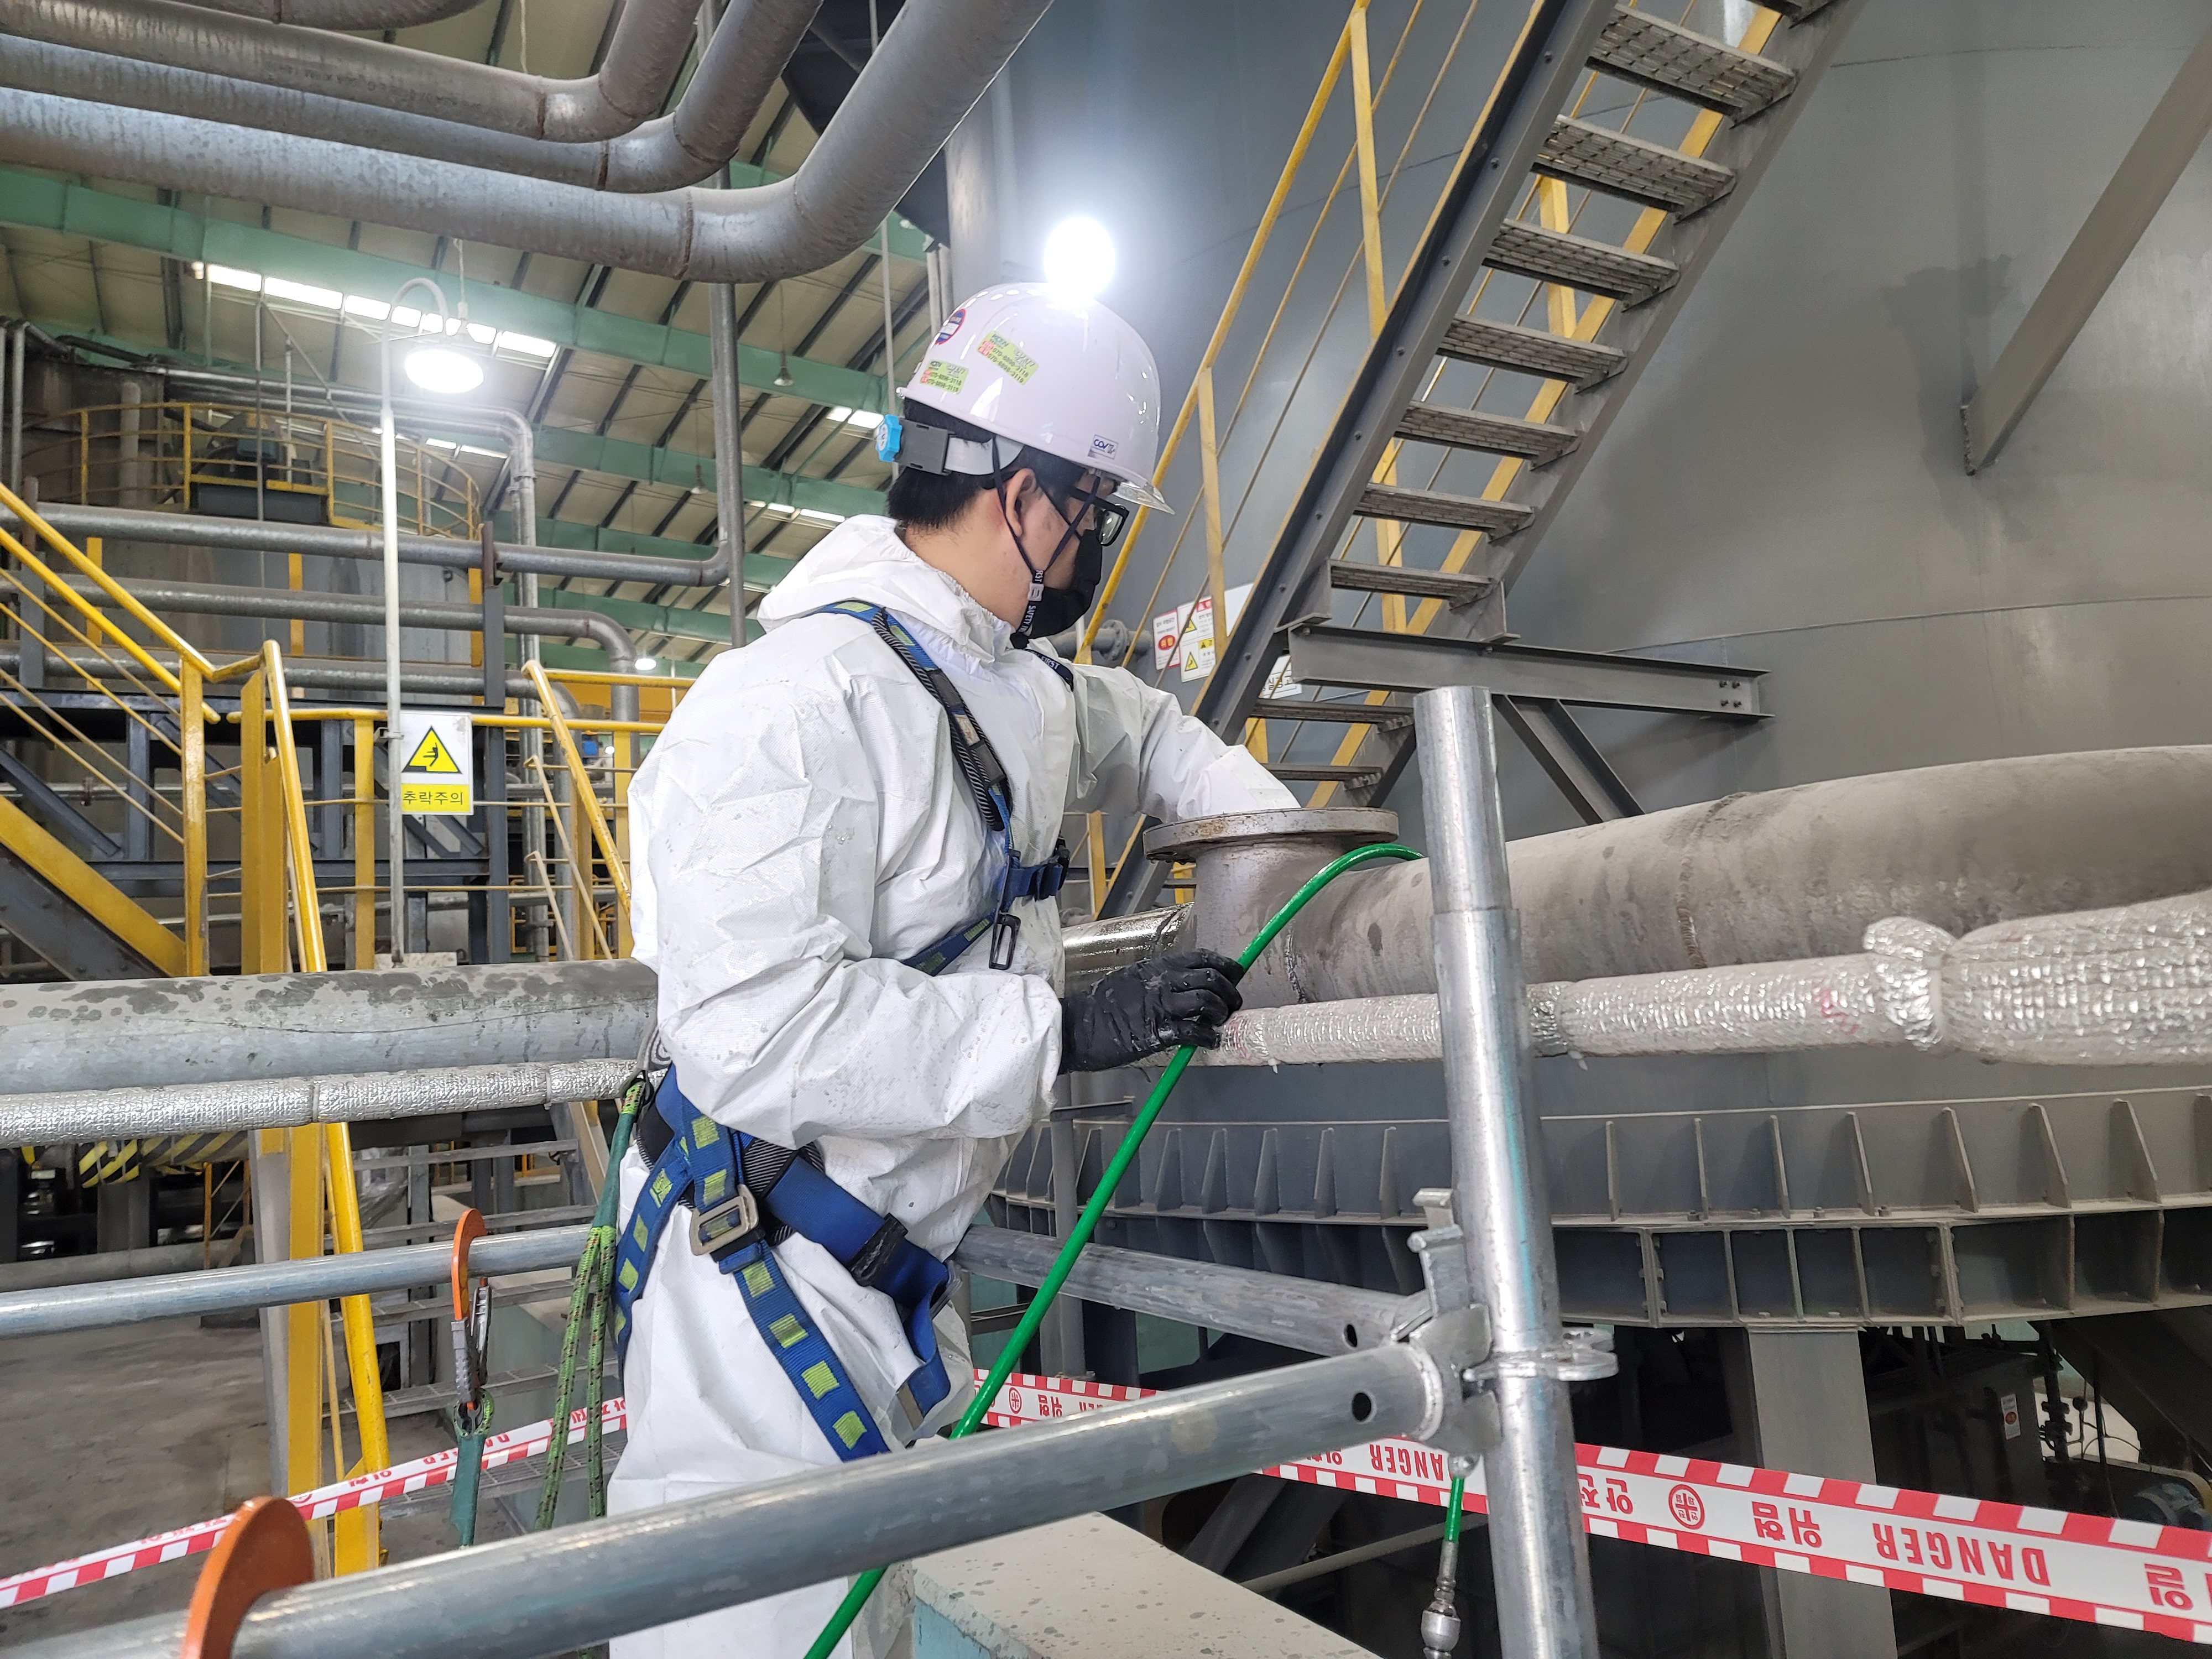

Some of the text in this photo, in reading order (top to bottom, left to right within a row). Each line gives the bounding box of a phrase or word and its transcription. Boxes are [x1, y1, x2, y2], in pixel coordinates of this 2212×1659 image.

[1023, 605, 1037, 628] SAFETY
[402, 791, 464, 806] 추락주의
[1369, 1443, 1451, 1481] ANGER
[1751, 1501, 1822, 1548] 위험
[1873, 1522, 2051, 1587] DANGER
[2144, 1563, 2212, 1612] 일
